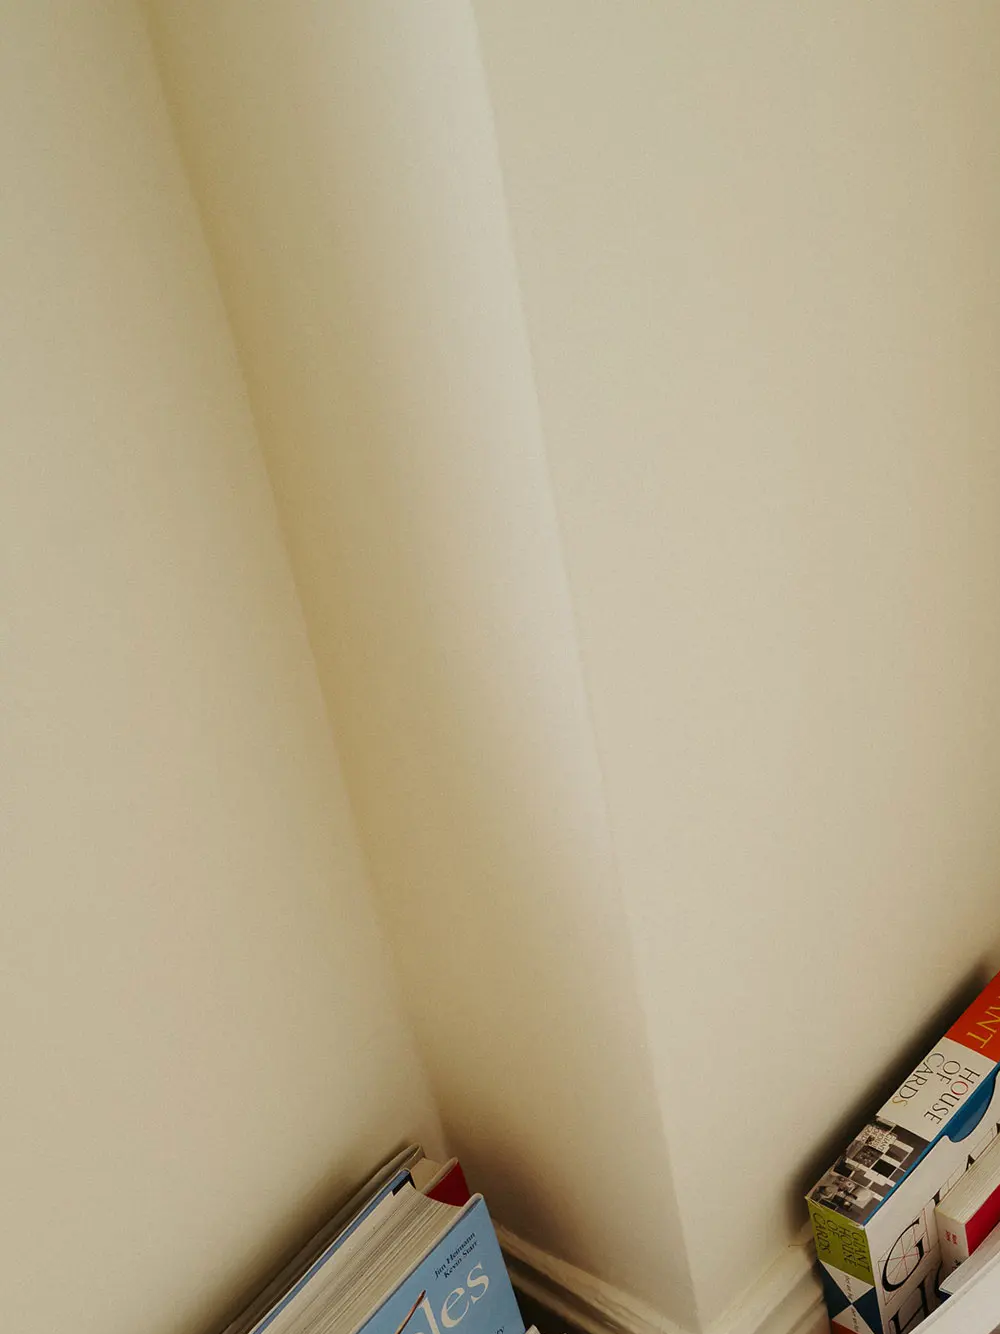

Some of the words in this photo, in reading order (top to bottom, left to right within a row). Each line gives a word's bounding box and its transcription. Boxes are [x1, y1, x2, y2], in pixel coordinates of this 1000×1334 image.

[891, 1052, 945, 1107] CARDS
[936, 1060, 961, 1085] OF
[923, 1067, 980, 1125] HOUSE
[827, 1219, 840, 1238] OF
[838, 1225, 857, 1267] HOUSE
[851, 1232, 871, 1272] GIANT
